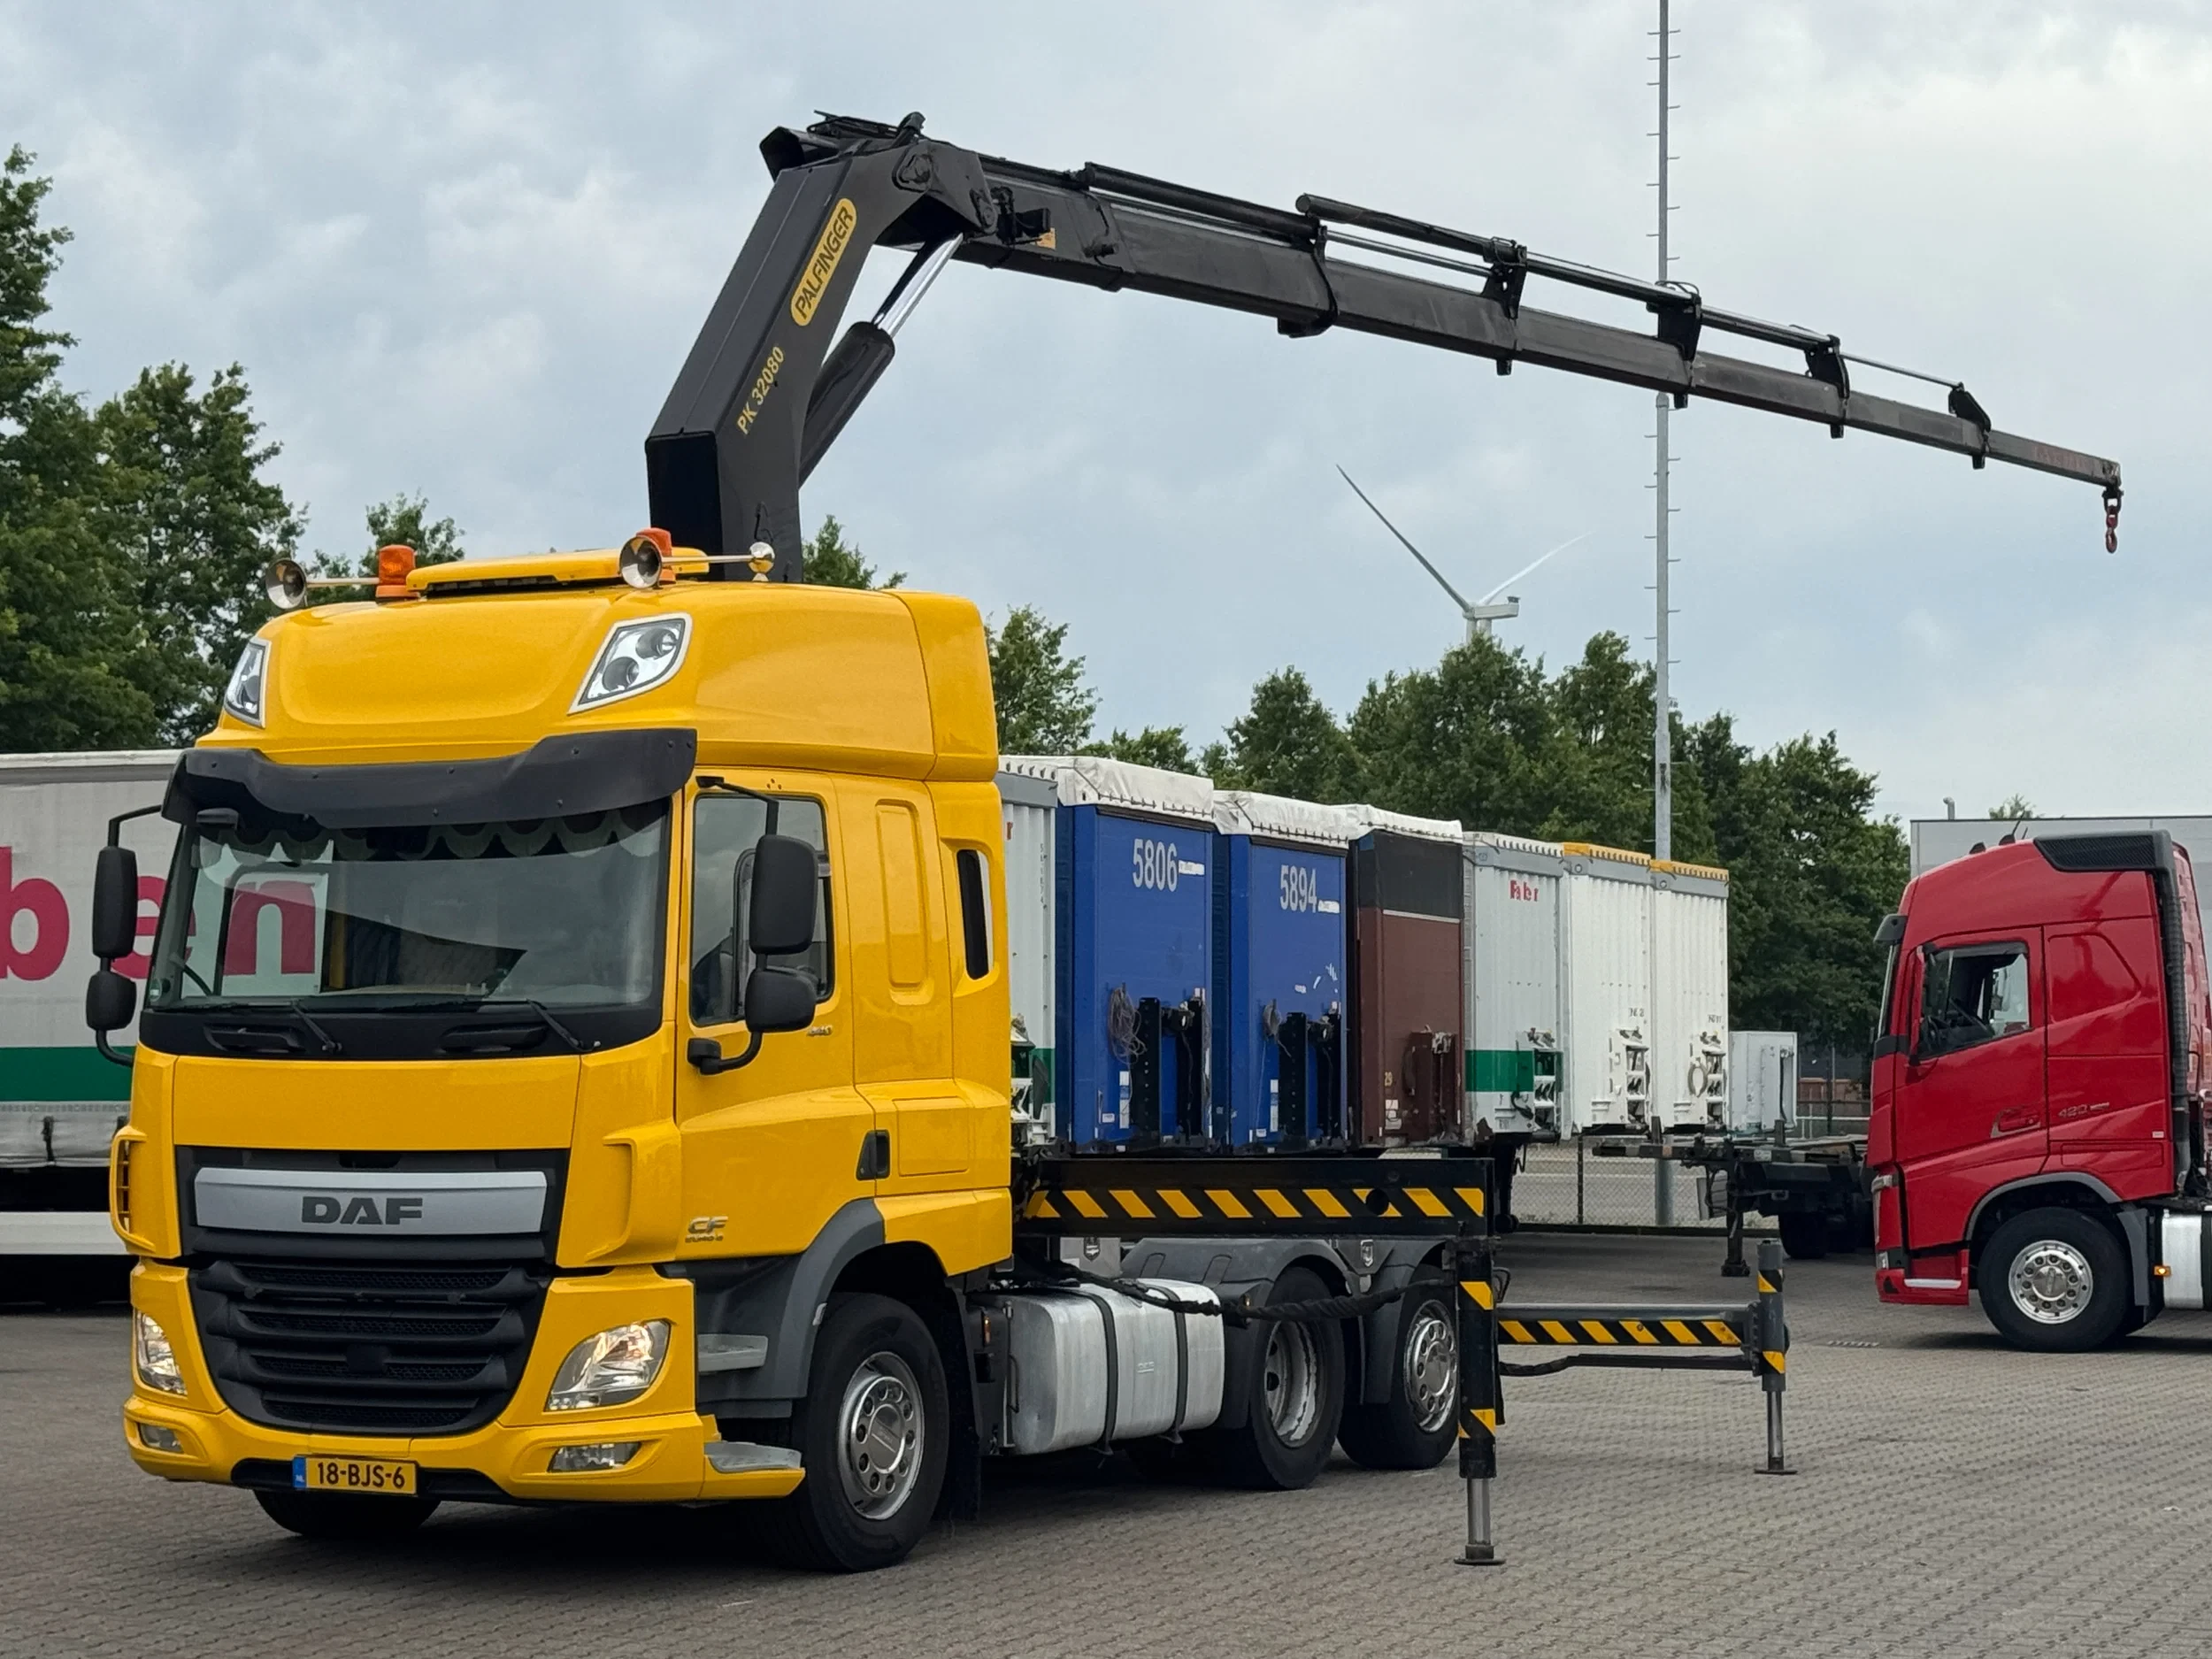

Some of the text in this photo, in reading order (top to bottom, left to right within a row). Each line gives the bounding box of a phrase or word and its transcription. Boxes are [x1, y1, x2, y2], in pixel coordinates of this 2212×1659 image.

[795, 206, 854, 320] PALFINGER
[737, 346, 785, 435] PK 32080
[1133, 838, 1178, 893] 5806
[1279, 864, 1317, 913] 5894
[302, 1196, 423, 1225] DAF
[317, 1461, 405, 1489] 18-BJS-6
